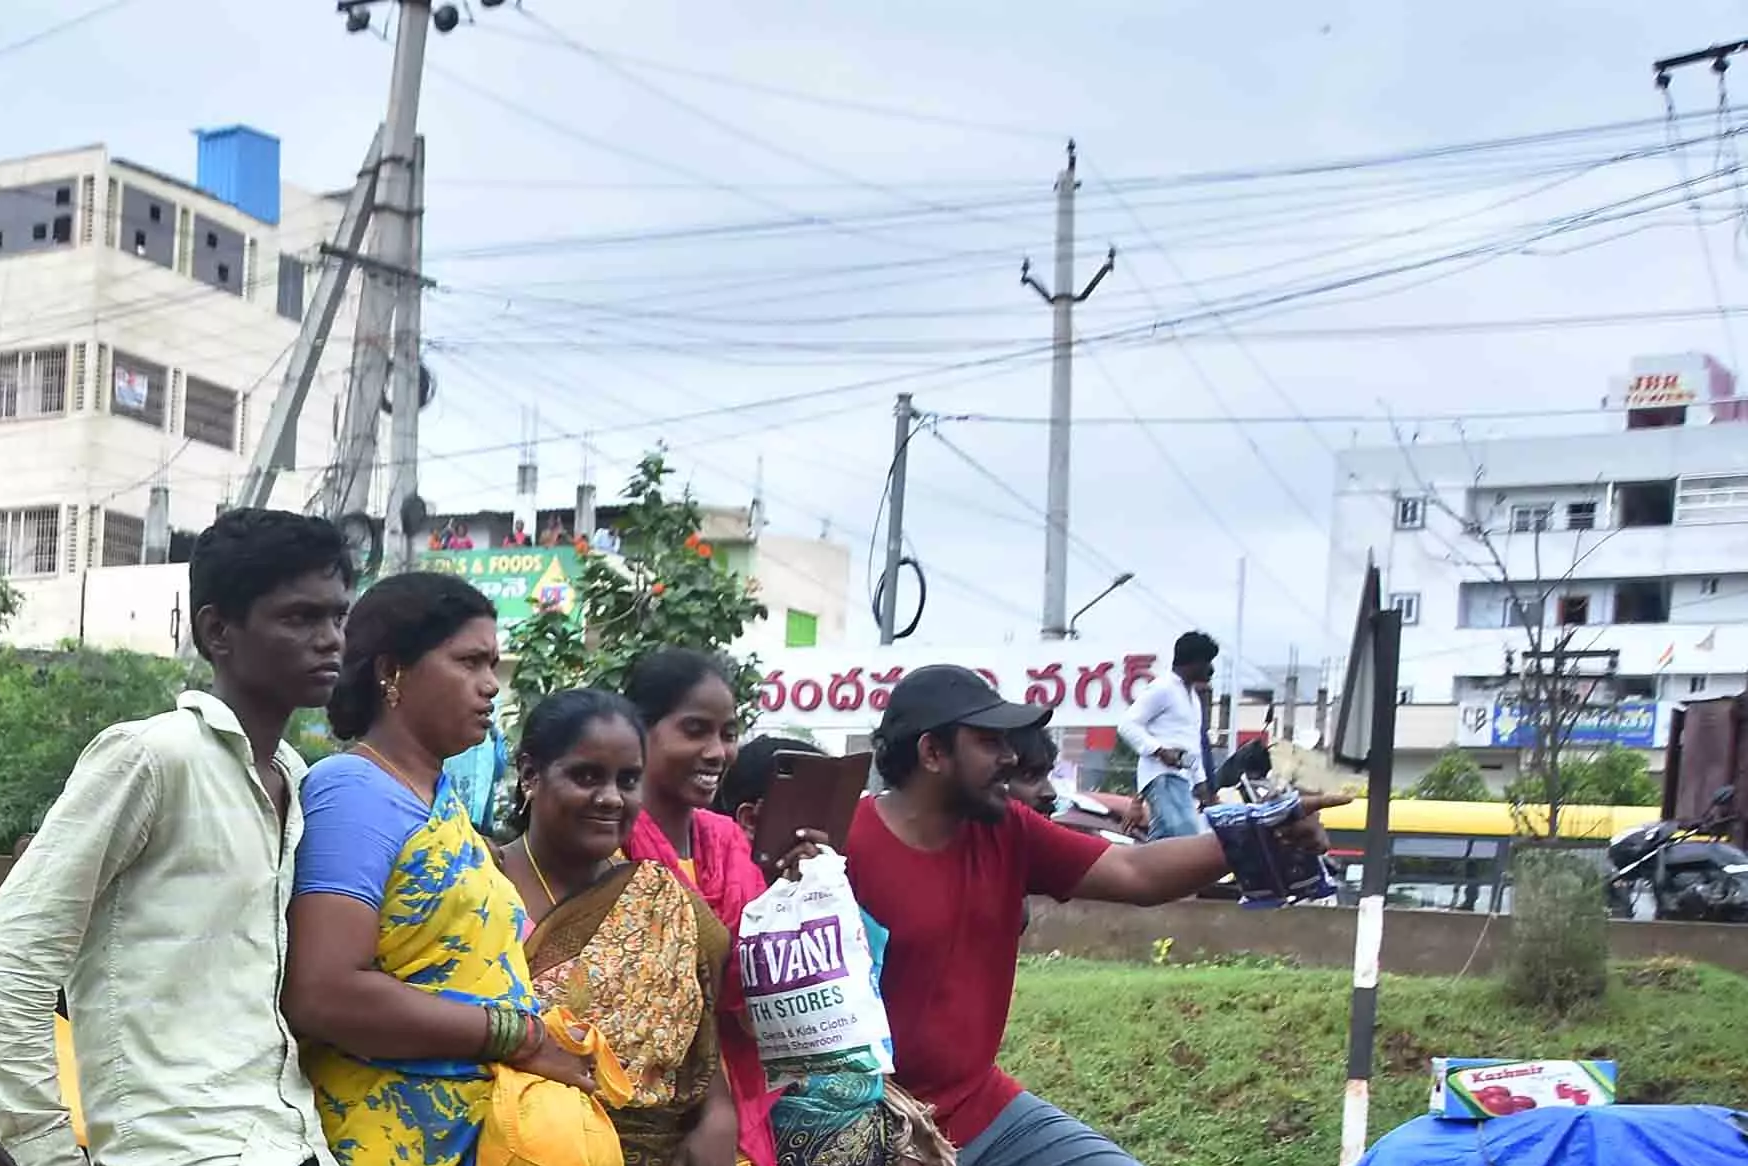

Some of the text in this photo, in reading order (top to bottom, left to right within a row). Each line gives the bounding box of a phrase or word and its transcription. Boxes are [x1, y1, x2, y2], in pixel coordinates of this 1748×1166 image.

[489, 555, 543, 574] FOODS
[763, 924, 842, 985] VANI
[775, 985, 845, 1019] STORES
[796, 1022, 818, 1036] Kids
[821, 1013, 849, 1032] Cloth
[790, 1032, 843, 1052] Showroom
